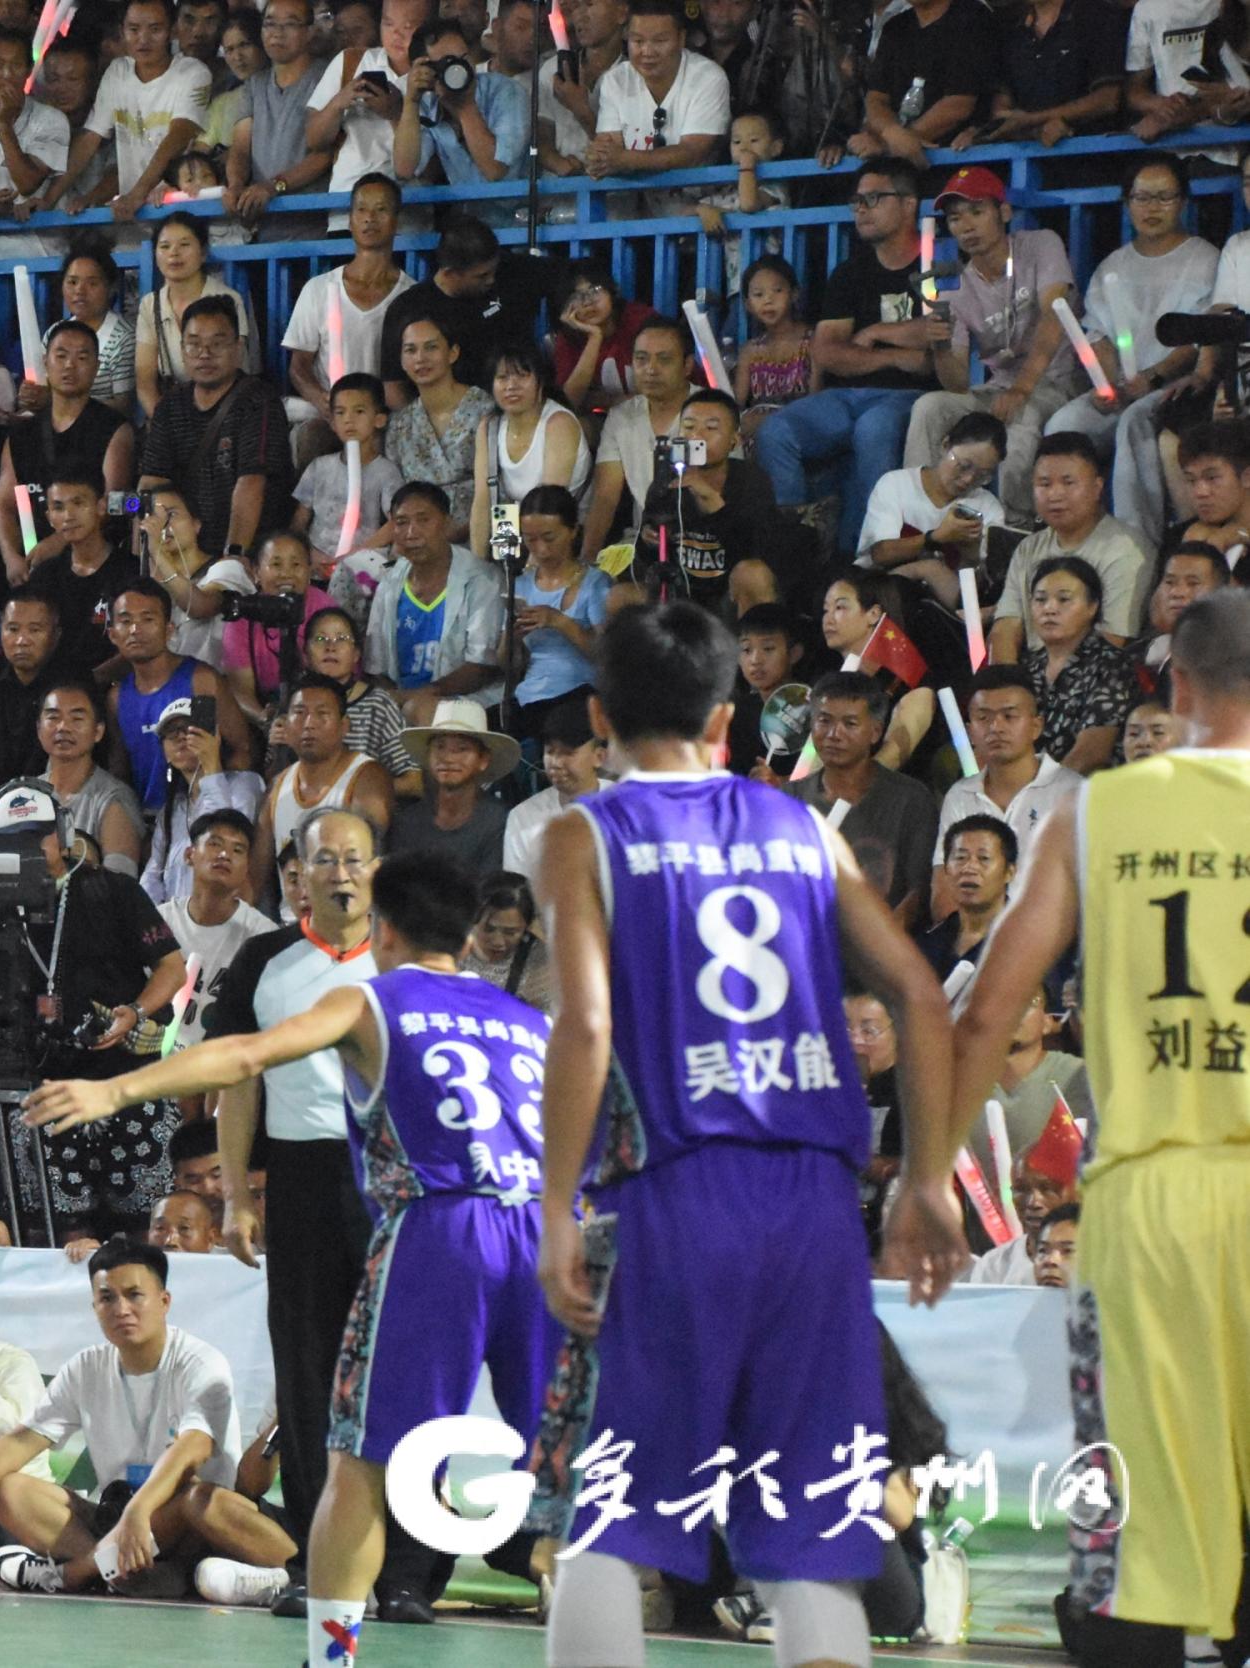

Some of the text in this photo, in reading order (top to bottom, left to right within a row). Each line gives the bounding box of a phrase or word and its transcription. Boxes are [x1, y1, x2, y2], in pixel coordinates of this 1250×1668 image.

[695, 883, 790, 1025] 8
[684, 1031, 842, 1102] 吴汉能
